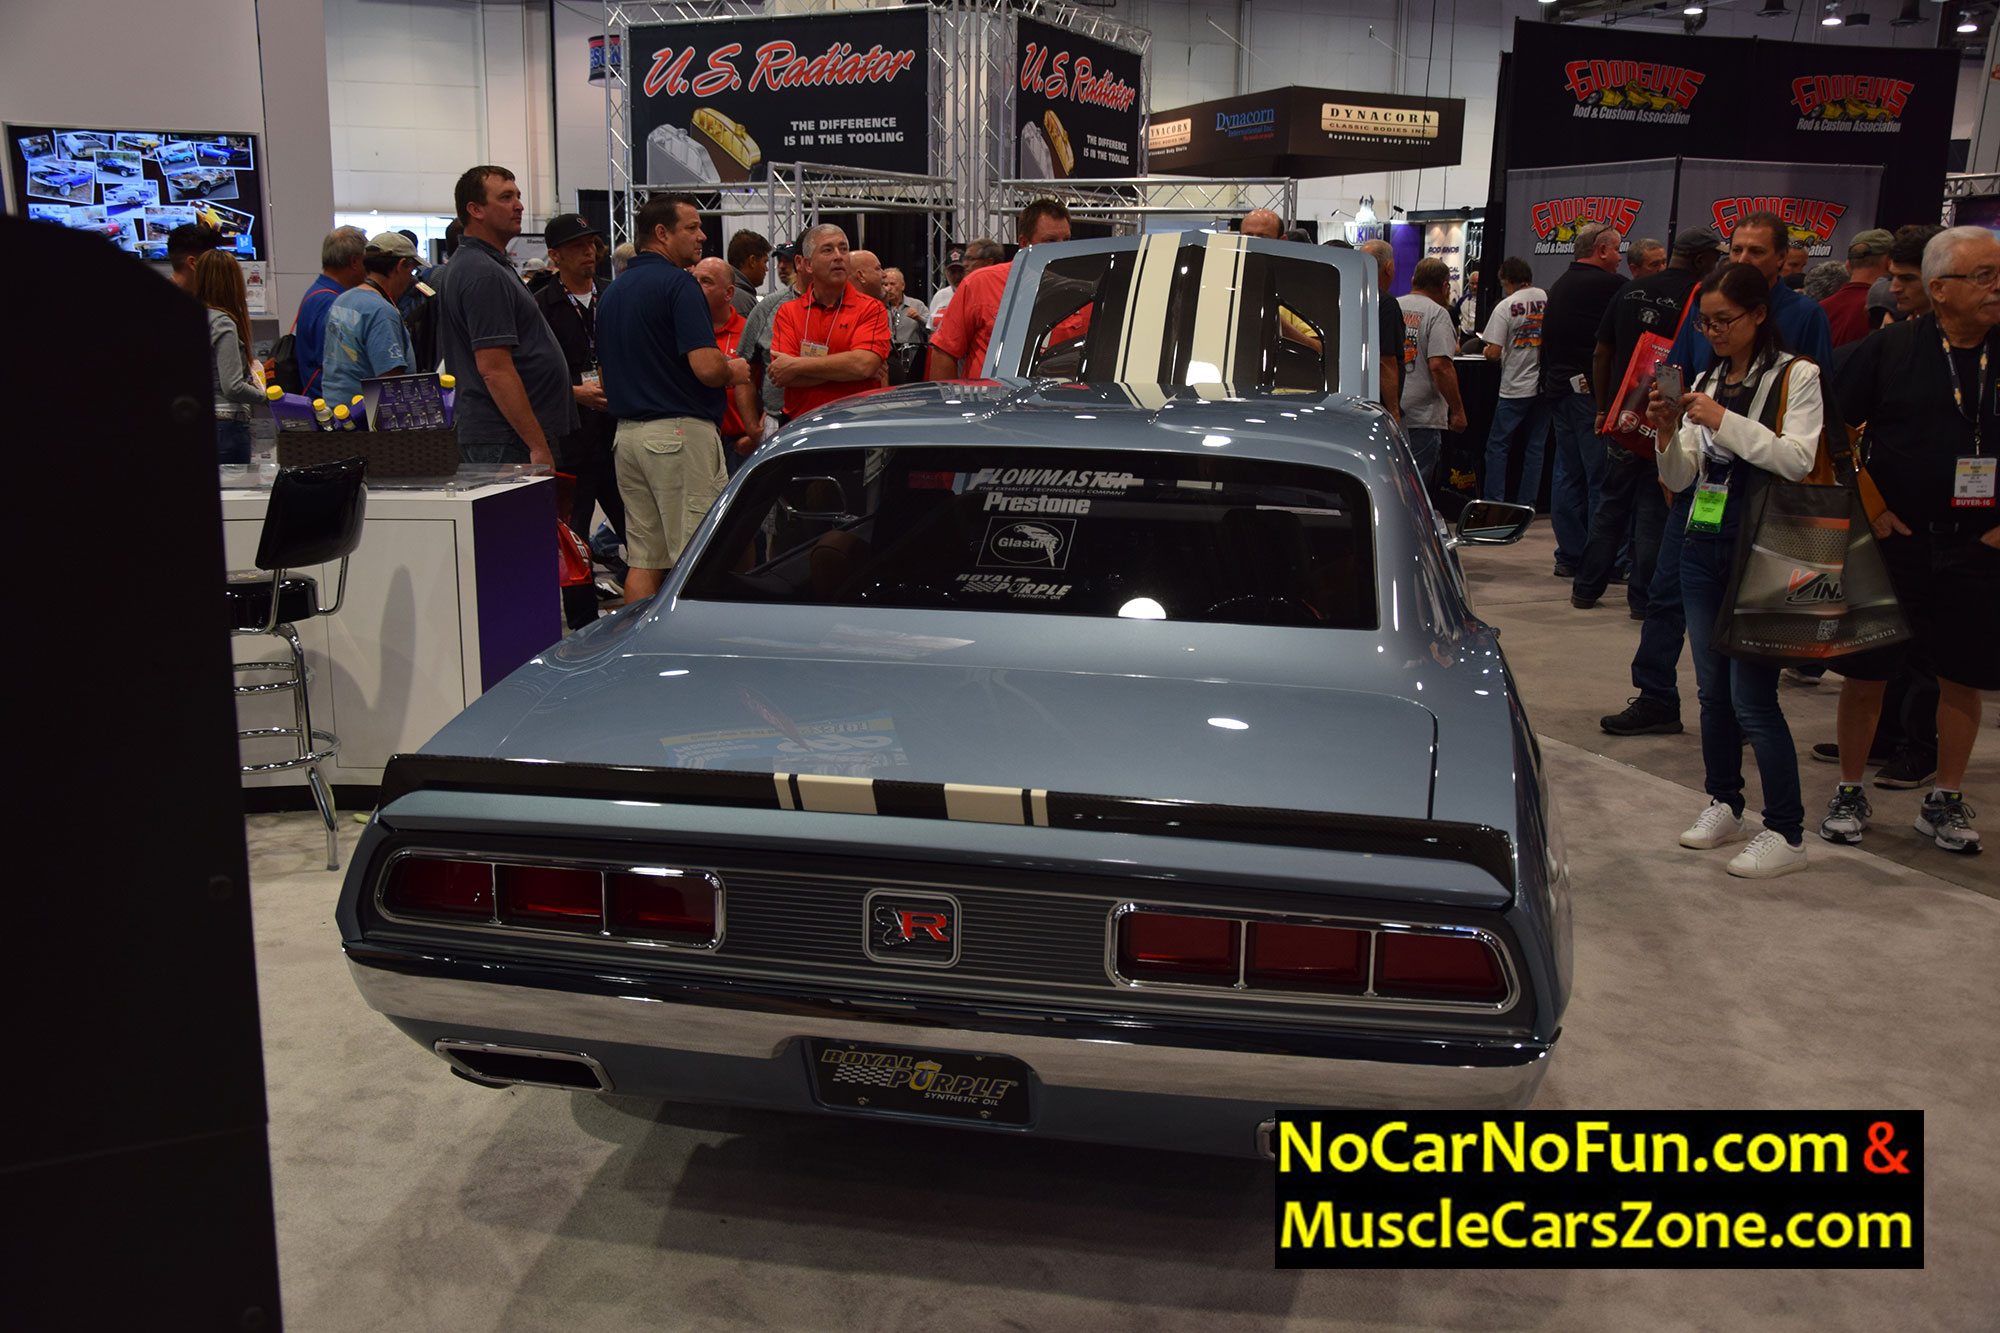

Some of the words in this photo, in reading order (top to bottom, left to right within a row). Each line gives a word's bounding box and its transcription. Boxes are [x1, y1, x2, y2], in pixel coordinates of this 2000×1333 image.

[644, 43, 742, 97] U.S.
[748, 40, 915, 92] Radiator
[1021, 42, 1069, 99] U.S.
[1070, 56, 1135, 113] Radiator
[1564, 60, 1706, 109] GOODGUYS
[1791, 75, 1915, 118] GOODGUYS
[1216, 108, 1274, 132] Dynacorn
[1330, 108, 1431, 124] DYNACORN
[1573, 104, 1591, 118] Rod
[1591, 108, 1598, 118] &
[1599, 106, 1636, 121] Custom
[1636, 109, 1691, 125] Association
[791, 121, 815, 132] THE
[819, 117, 897, 130] DIFFERENCE
[1149, 123, 1188, 138] YNACORN
[1329, 122, 1369, 131] CLASSIC
[1796, 118, 1814, 131] Rod
[1814, 120, 1820, 131] &
[1821, 119, 1852, 132] Custom
[1852, 120, 1901, 132] Association
[784, 136, 796, 146] IS
[800, 135, 814, 145] IN
[818, 134, 843, 145] THE
[847, 131, 904, 144] TOOLING
[1086, 134, 1097, 145] THE
[1098, 137, 1127, 152] DIFFERENCE
[1328, 133, 1380, 143] Replacement
[1083, 147, 1089, 157] IS
[1090, 149, 1096, 159] IN
[1097, 150, 1107, 161] THE
[1108, 152, 1129, 165] TOOLING
[1531, 196, 1643, 239] GOODGUYS
[1534, 242, 1550, 254] Rod
[1550, 244, 1556, 253] &
[1555, 242, 1575, 254] Custo
[966, 468, 1134, 490] FLOWMASTER
[1032, 487, 1086, 495] TECHNOLOGY
[983, 491, 1091, 514] Prestone
[955, 574, 1013, 583] ROYAL
[992, 582, 1072, 596] PURPLE
[821, 1049, 913, 1069] ROYAL
[887, 1066, 1012, 1099] PURPLE
[924, 1092, 978, 1104] SYNTHETIC
[982, 1097, 999, 1106] OIL
